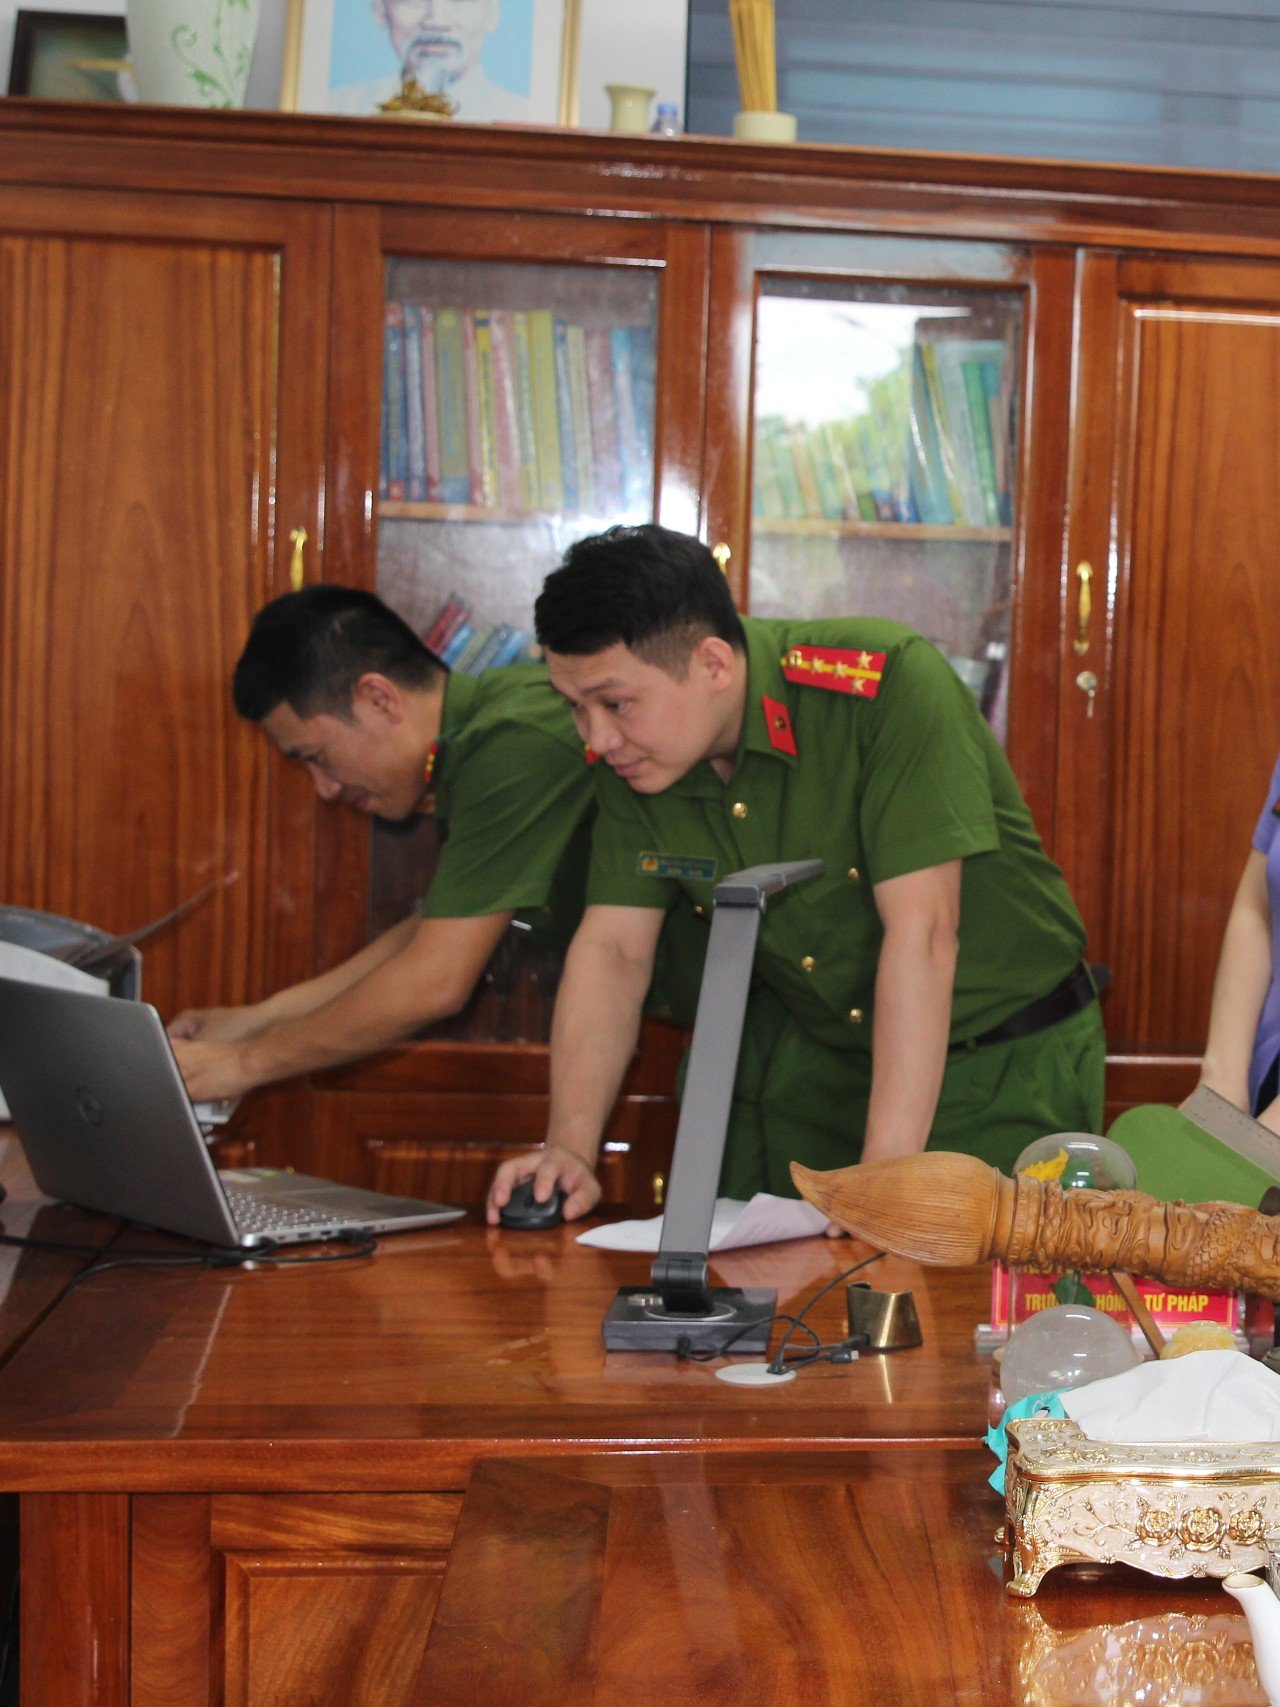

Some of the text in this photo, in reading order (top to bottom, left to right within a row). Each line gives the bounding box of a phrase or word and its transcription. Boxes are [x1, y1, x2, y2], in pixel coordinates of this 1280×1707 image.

[1093, 1290, 1128, 1311] HÒN
[1144, 1292, 1165, 1312] TƯ
[1167, 1290, 1209, 1312] PHÁP
